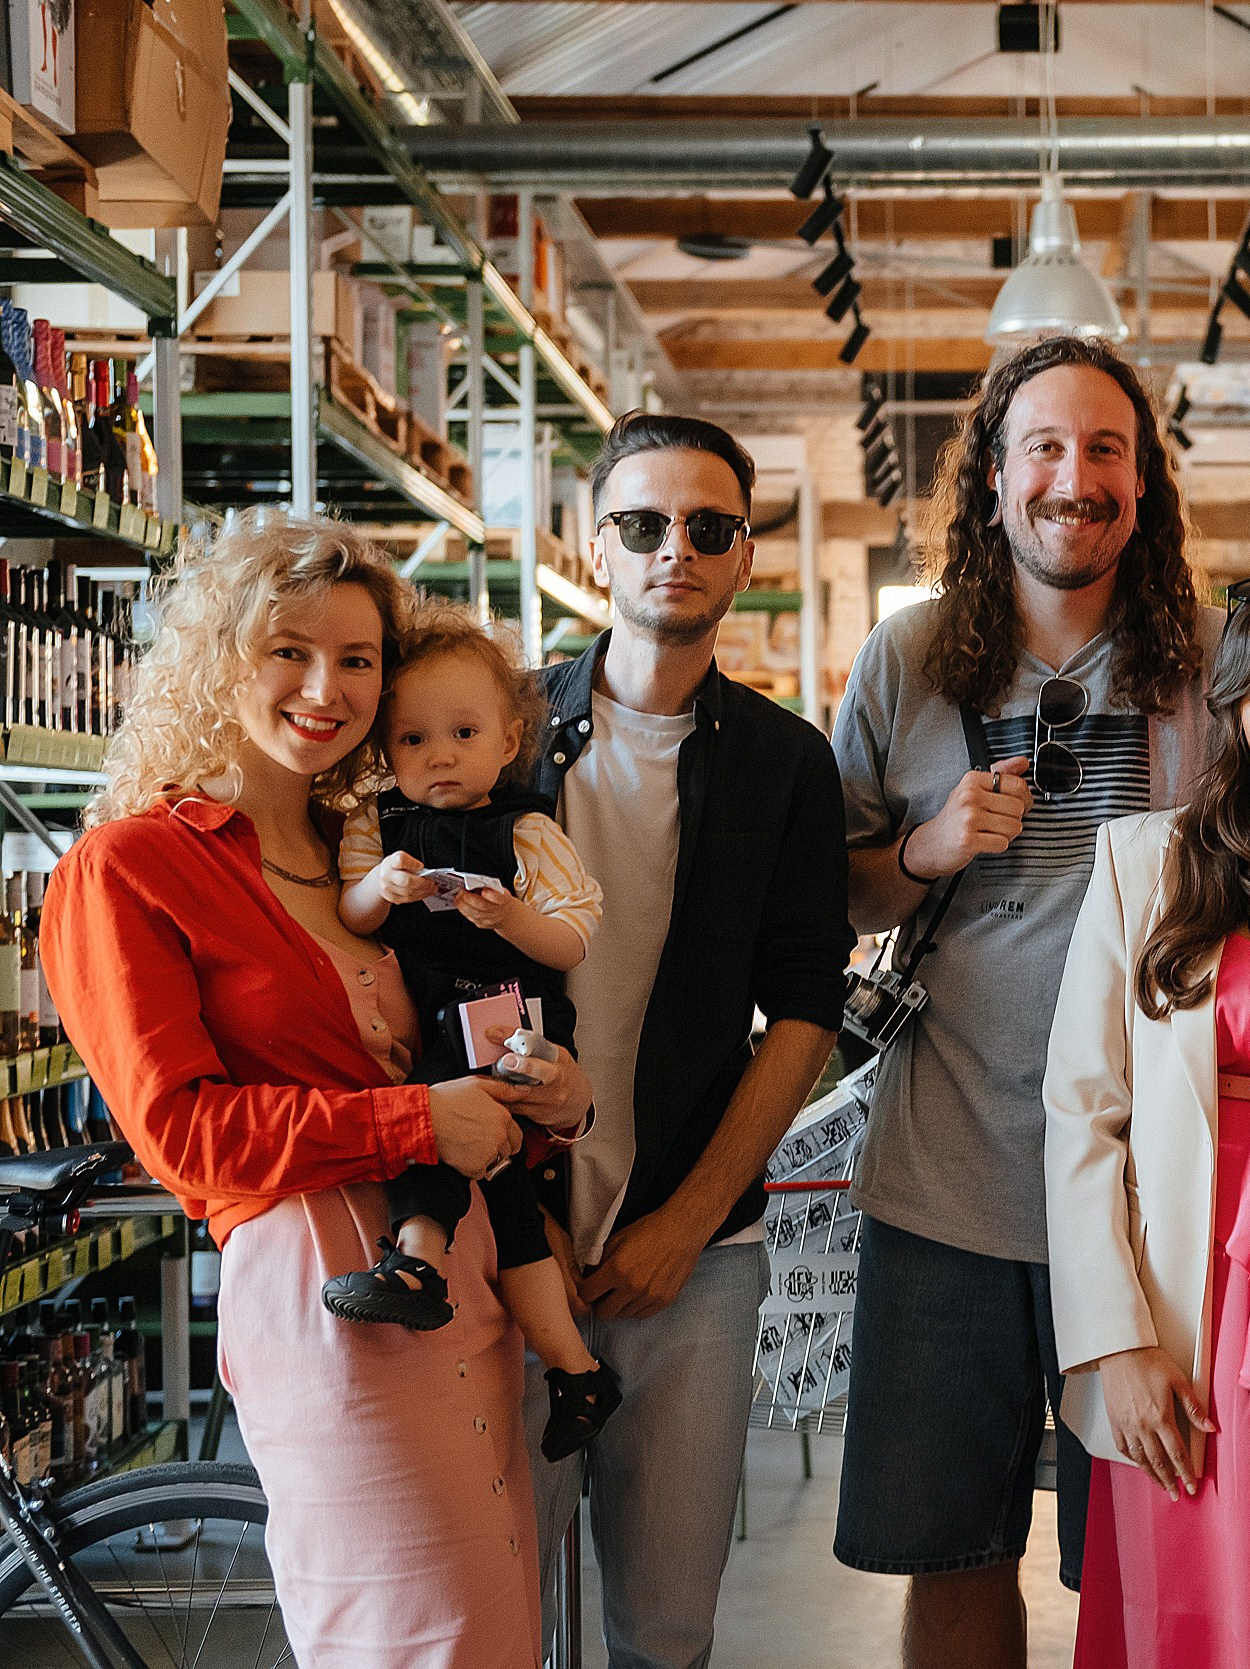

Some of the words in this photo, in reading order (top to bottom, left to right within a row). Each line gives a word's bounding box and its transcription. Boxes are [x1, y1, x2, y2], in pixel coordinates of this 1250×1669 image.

[9, 1520, 31, 1549] BORN
[27, 1550, 39, 1562] IN
[37, 1563, 53, 1584] THE
[50, 1585, 81, 1631] STREETS
